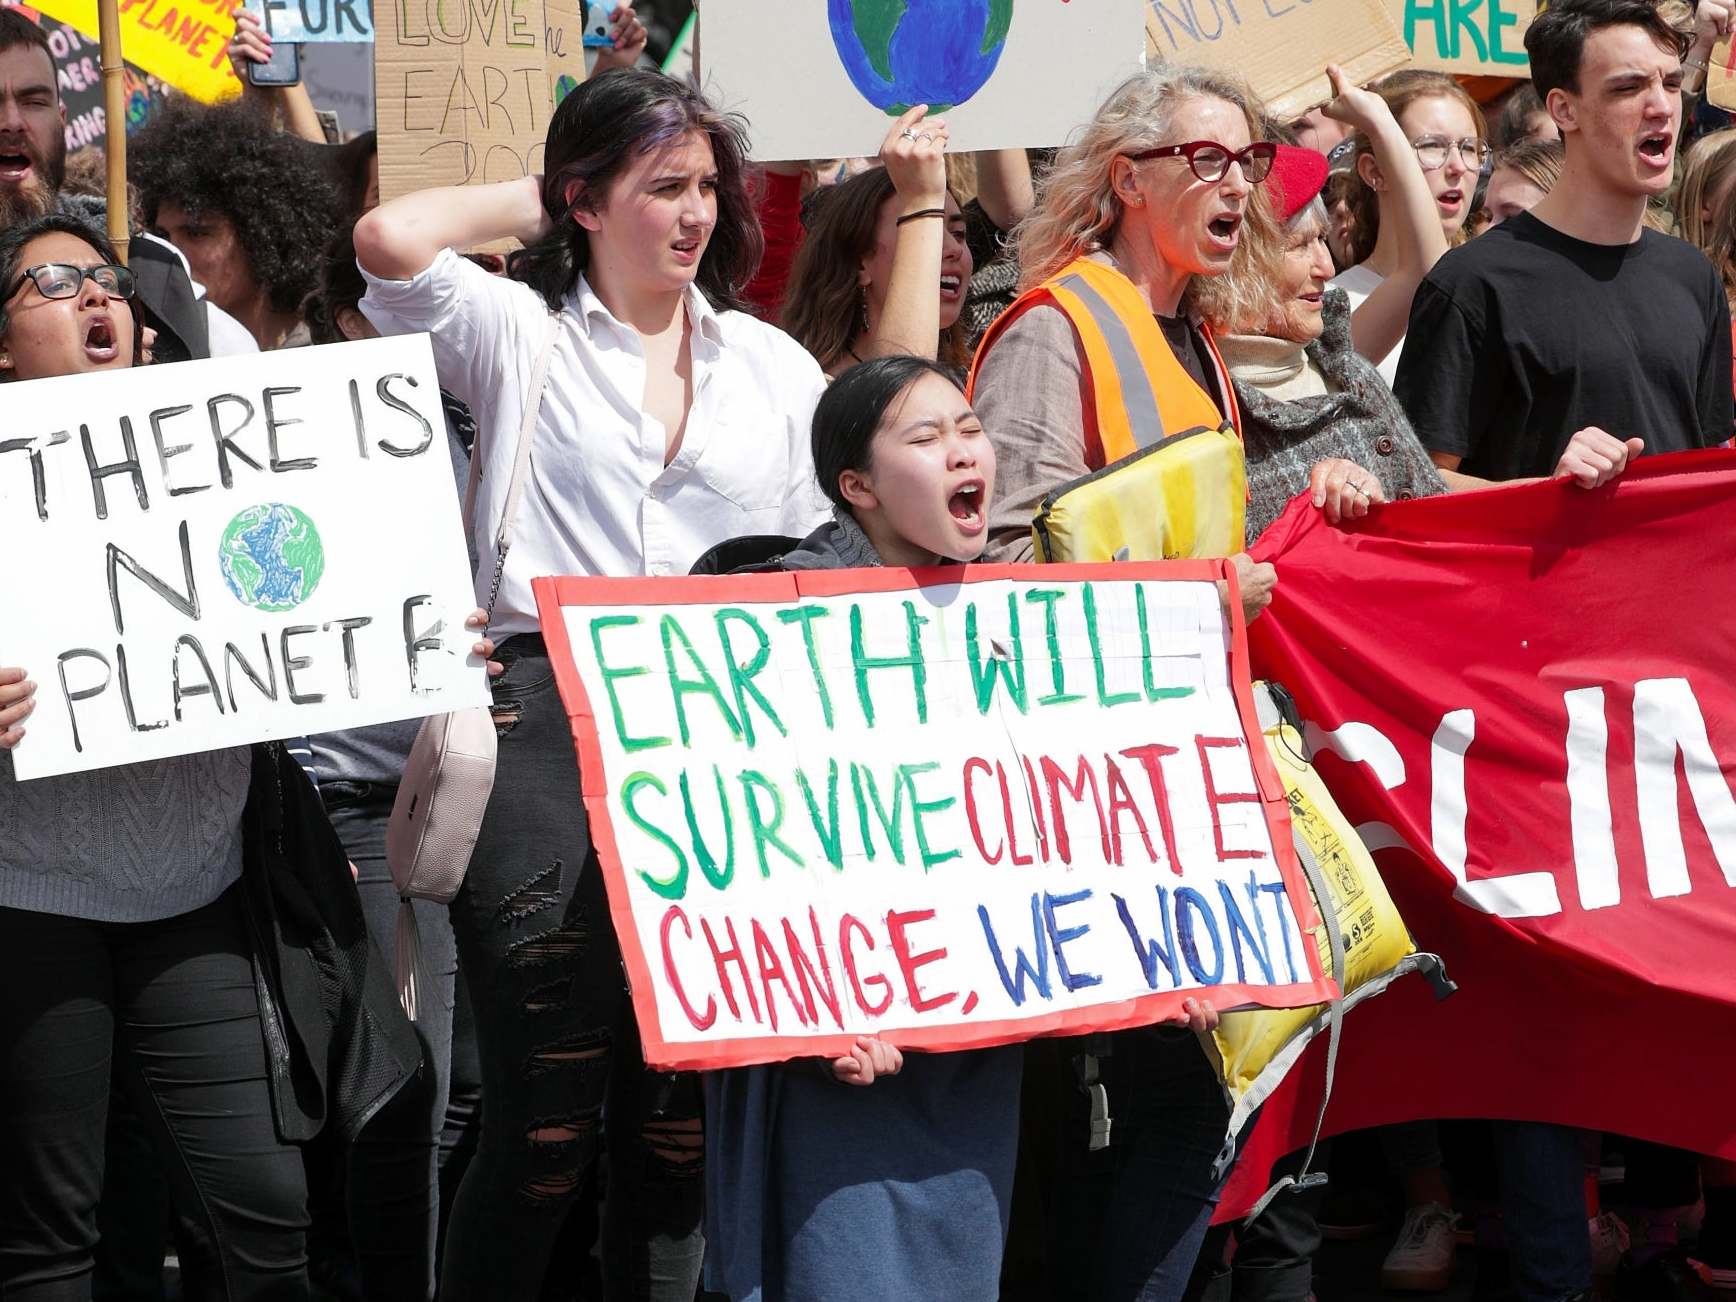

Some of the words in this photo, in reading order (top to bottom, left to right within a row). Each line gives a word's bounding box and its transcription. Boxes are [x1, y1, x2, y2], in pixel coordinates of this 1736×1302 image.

[394, 0, 535, 47] LOVE
[0, 386, 320, 522] THERE
[348, 373, 433, 459] IS
[57, 616, 374, 753] PLANET
[590, 600, 929, 754] EARTH
[965, 581, 1197, 716] WILL
[620, 757, 964, 900] SURVIVE
[963, 734, 1268, 877] CLIMATE
[660, 904, 979, 1033] CHANGE,
[977, 888, 1103, 1008] WE
